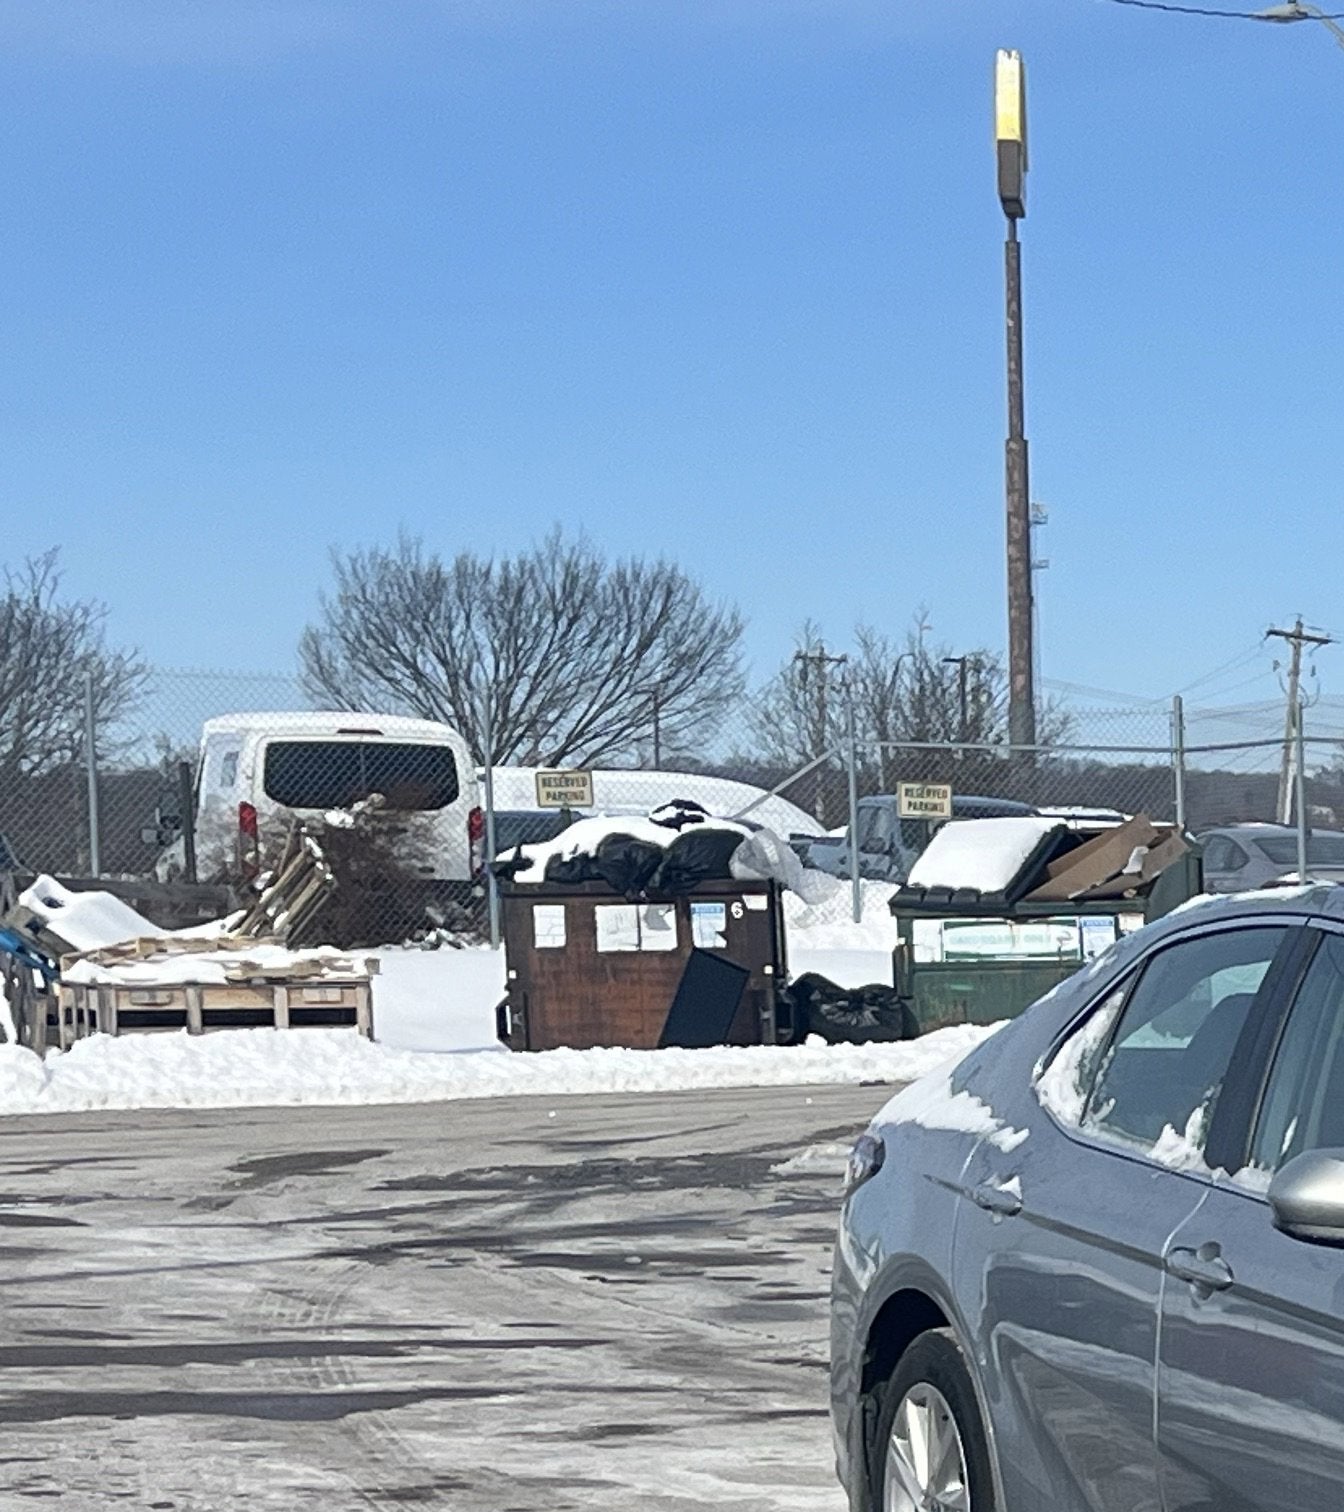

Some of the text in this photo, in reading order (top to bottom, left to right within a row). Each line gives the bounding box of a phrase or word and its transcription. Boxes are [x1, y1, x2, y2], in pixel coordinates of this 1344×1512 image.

[541, 776, 588, 788] RESERVED
[545, 790, 585, 801] PARKING
[904, 787, 948, 799] RESERVED
[907, 800, 945, 813] PARKING
[730, 901, 744, 919] 6
